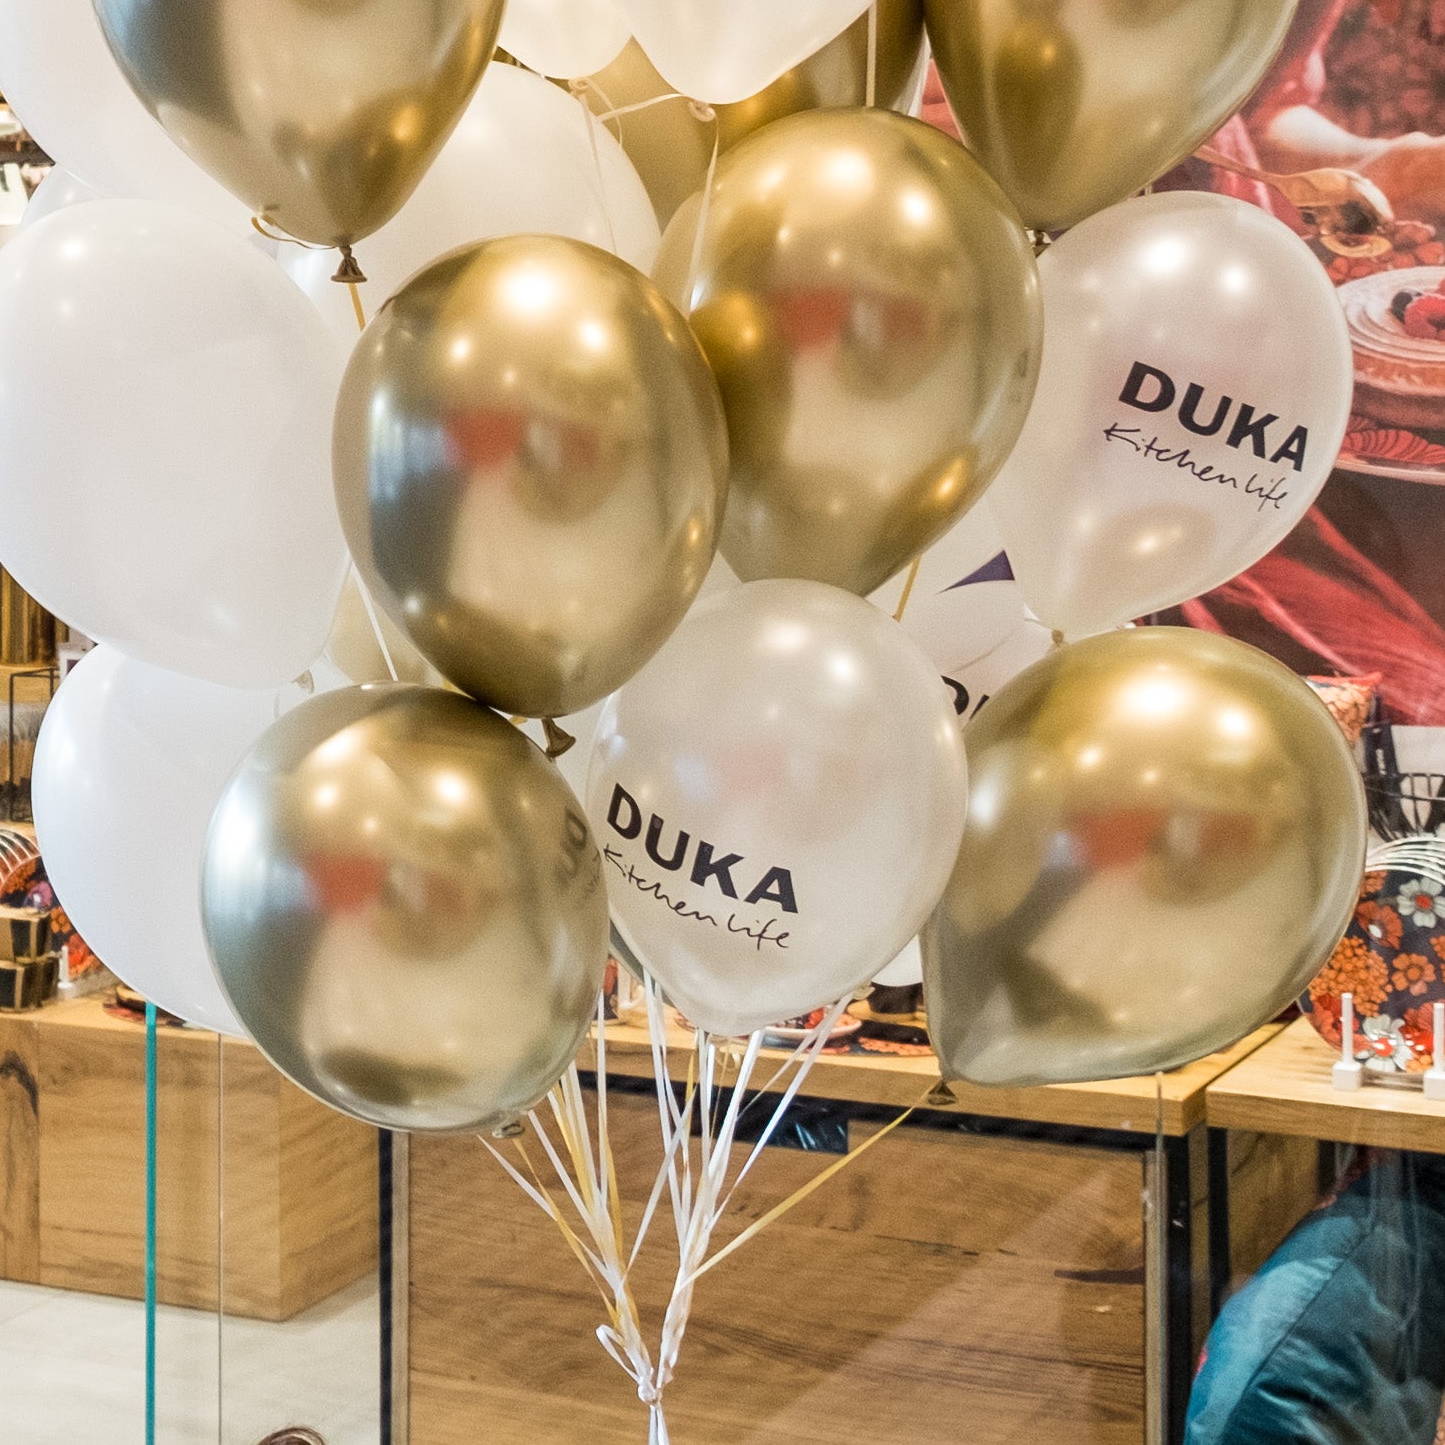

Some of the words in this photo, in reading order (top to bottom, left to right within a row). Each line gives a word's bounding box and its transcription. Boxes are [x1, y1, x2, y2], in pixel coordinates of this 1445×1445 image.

[1104, 422, 1238, 489] Kitchen
[1245, 473, 1288, 512] life
[1118, 360, 1308, 472] DUKA
[604, 843, 717, 926] Kitchen
[727, 913, 790, 951] life
[607, 782, 799, 914] DUKA
